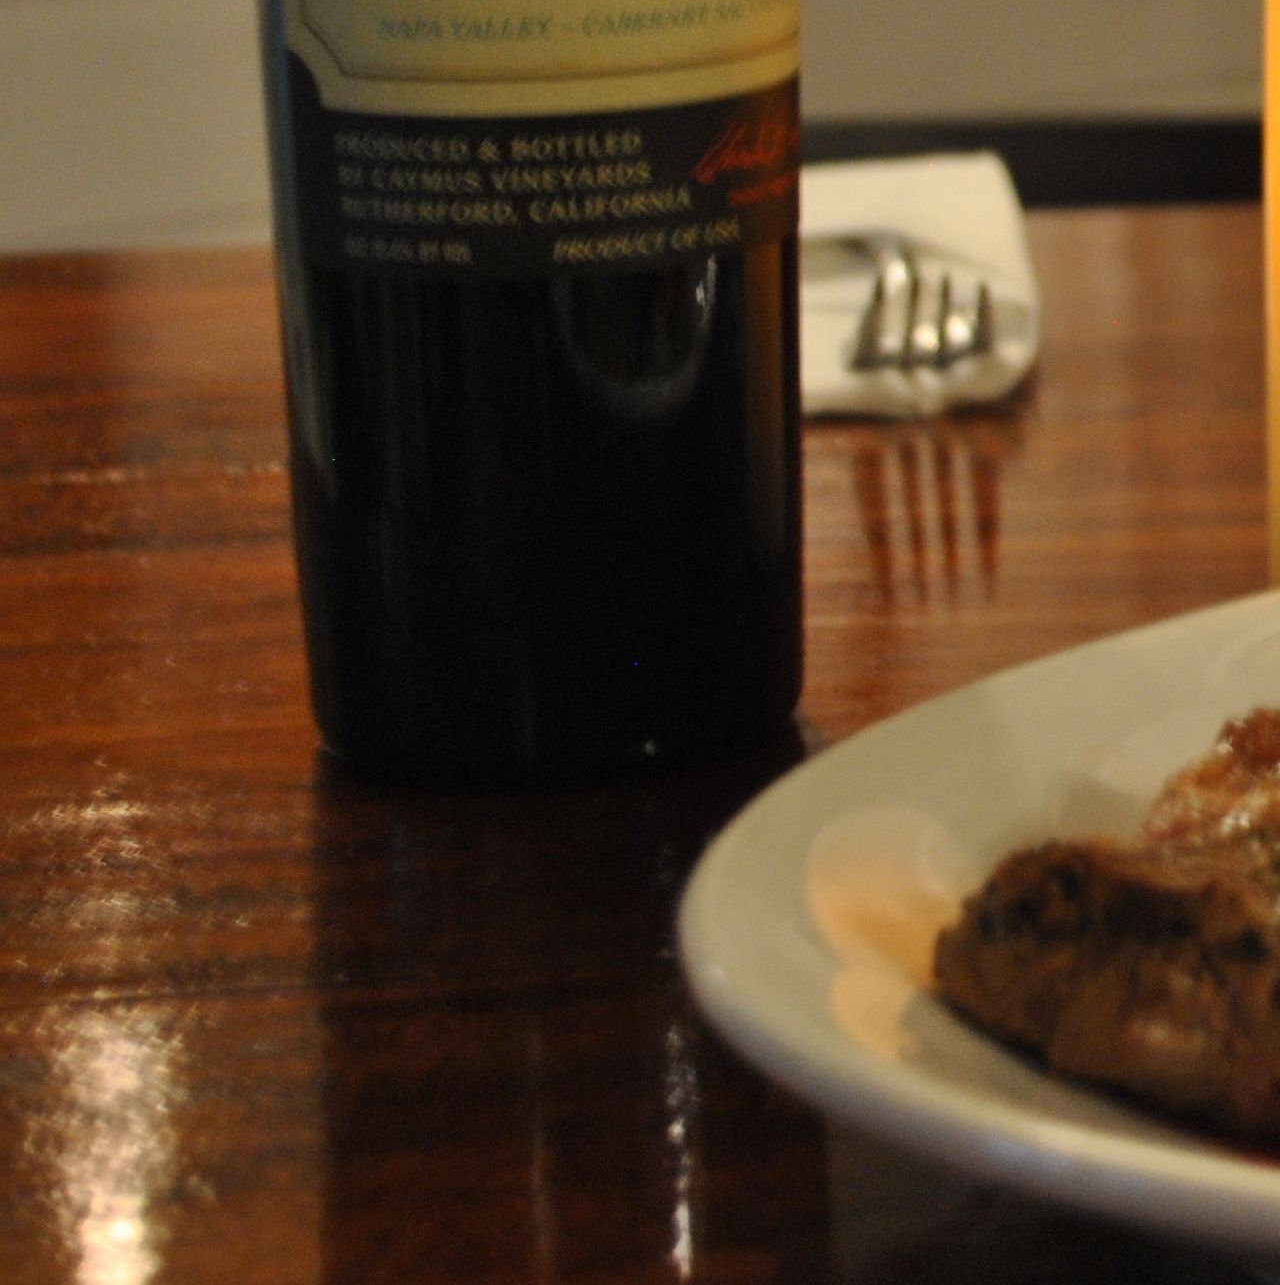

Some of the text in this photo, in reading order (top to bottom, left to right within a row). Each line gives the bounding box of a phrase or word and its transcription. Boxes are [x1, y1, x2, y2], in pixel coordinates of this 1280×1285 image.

[480, 137, 501, 161] &
[512, 129, 643, 161] BOTTLED
[370, 167, 482, 195] CAYMUS
[491, 160, 652, 193] VINEYARDS
[529, 185, 692, 223] CALIFORNIA
